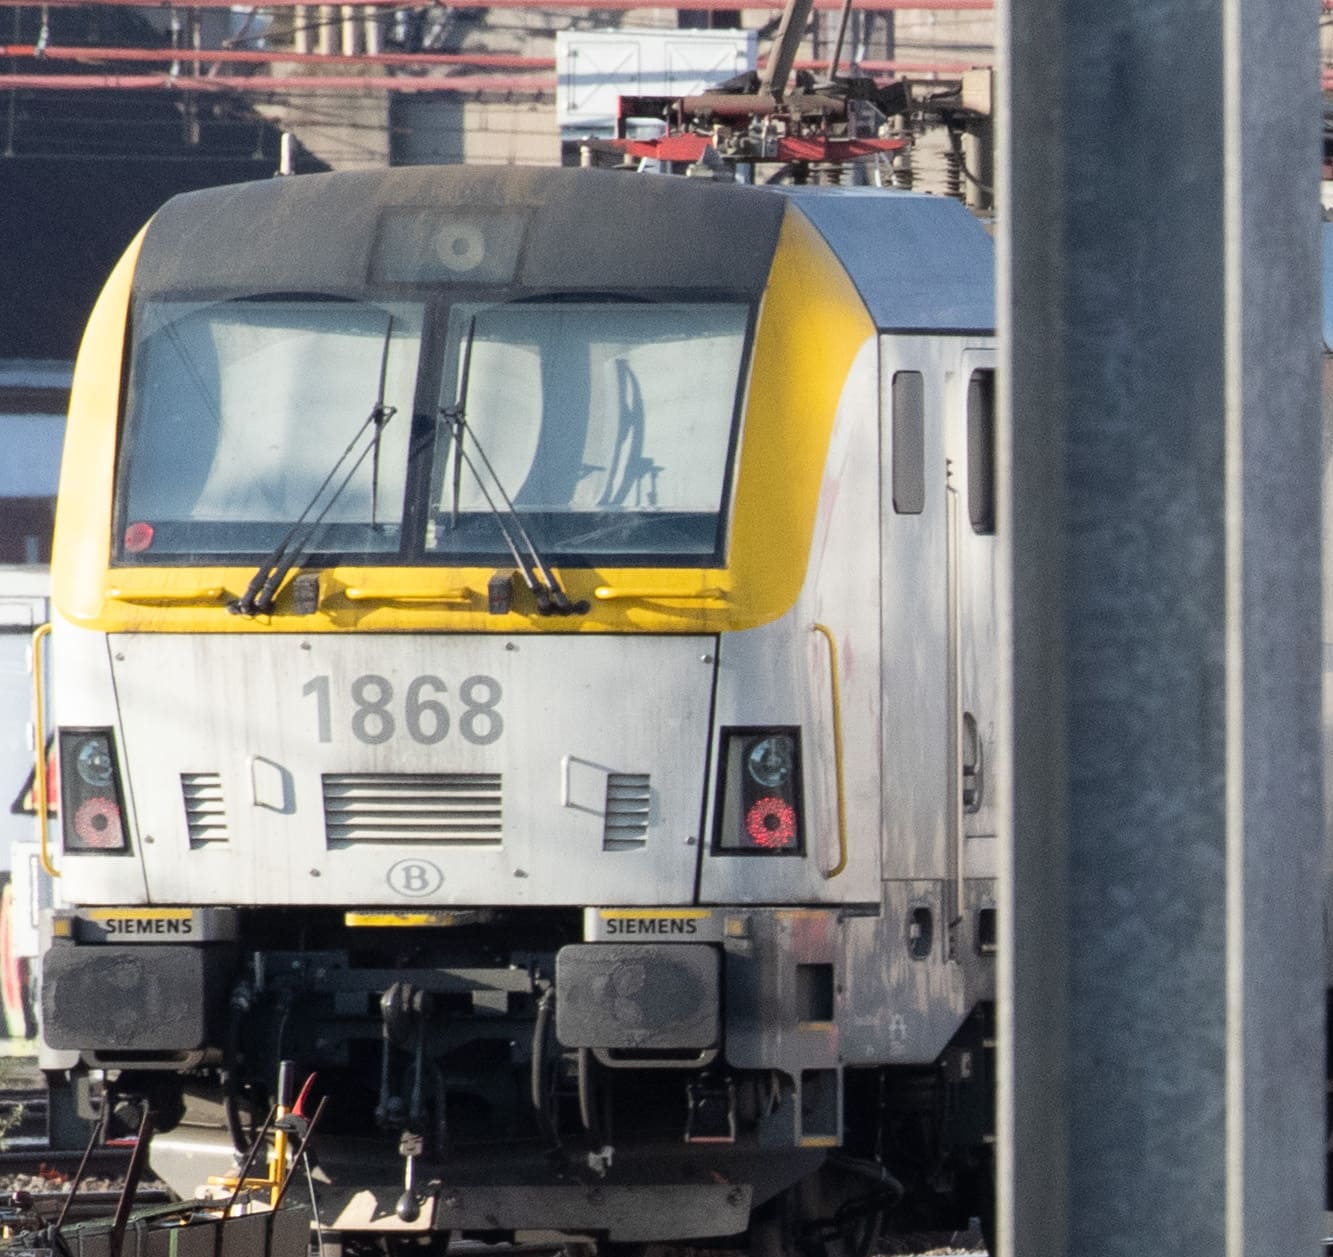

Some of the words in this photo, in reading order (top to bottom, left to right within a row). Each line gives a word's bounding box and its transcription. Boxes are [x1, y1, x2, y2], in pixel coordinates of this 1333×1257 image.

[302, 674, 505, 746] 1868
[106, 918, 193, 934] SIEMENS
[606, 918, 698, 934] SIEMENS
